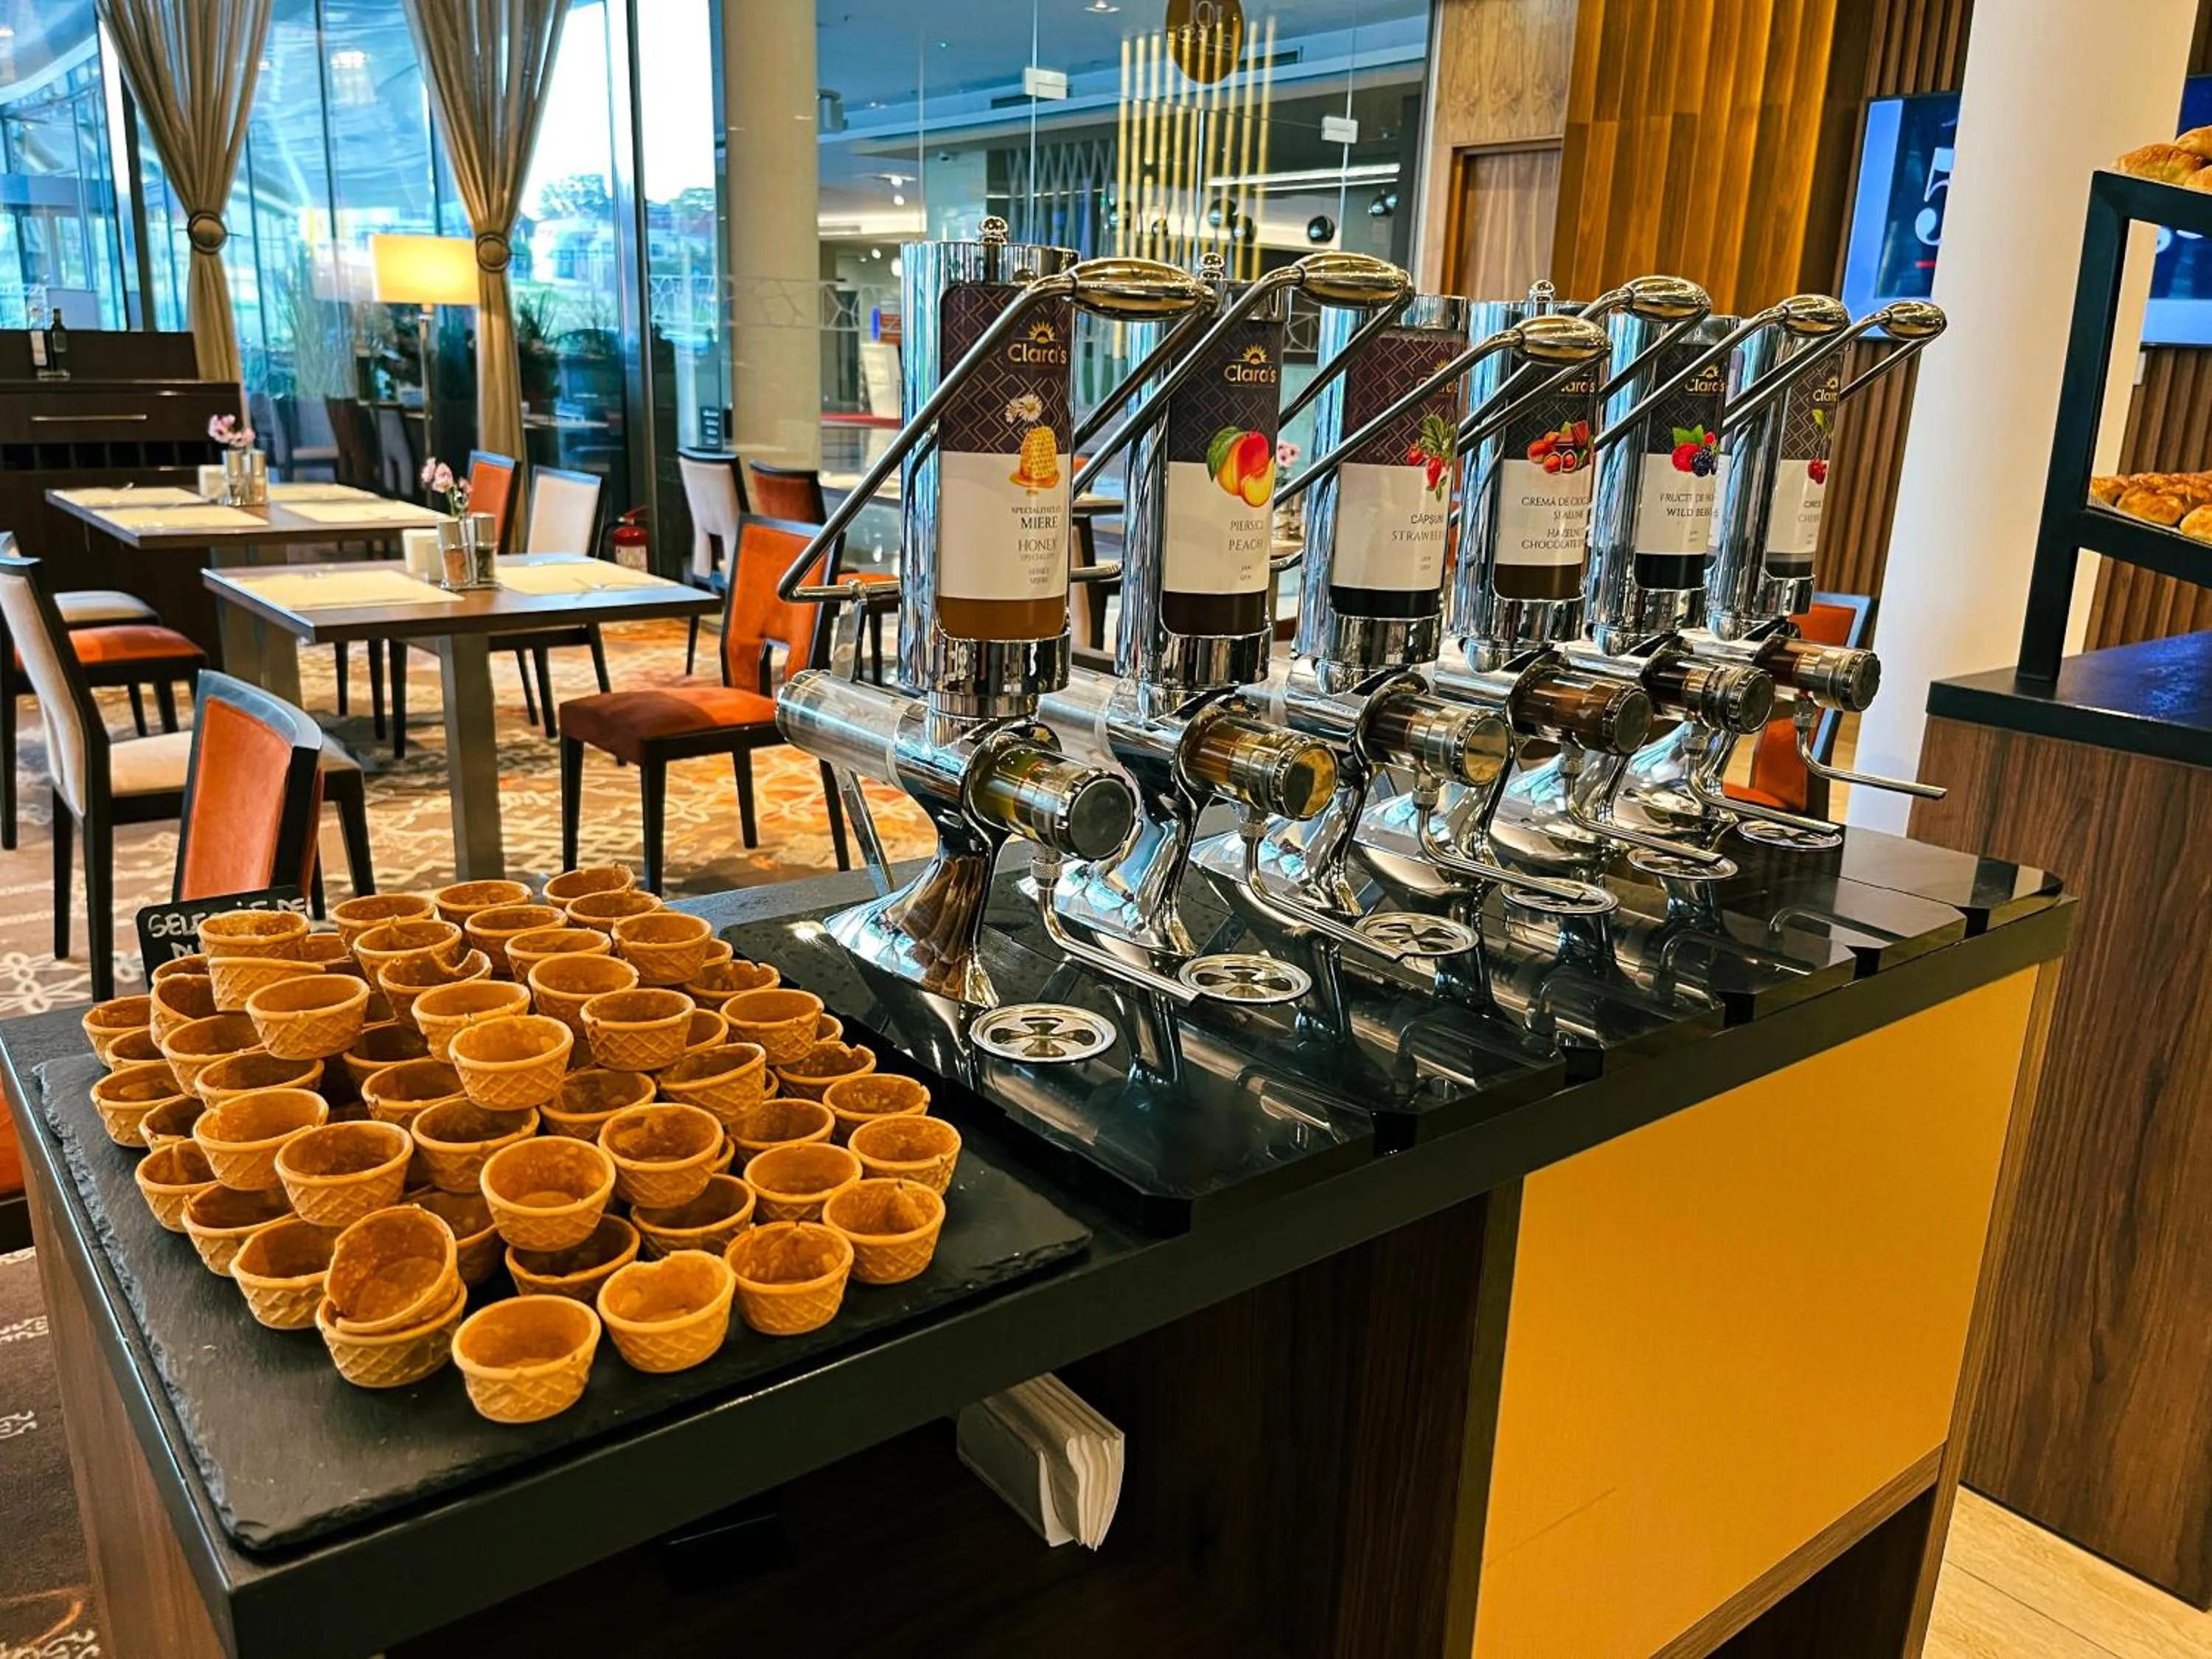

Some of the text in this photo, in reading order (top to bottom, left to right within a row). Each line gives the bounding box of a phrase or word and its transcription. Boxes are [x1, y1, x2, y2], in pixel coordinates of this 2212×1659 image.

[1007, 343, 1067, 365] Clara's
[1224, 364, 1276, 383] Clara's
[1666, 507, 1694, 517] WILD
[1021, 516, 1058, 529] MIERE
[1018, 538, 1057, 552] HONEY
[1228, 538, 1263, 551] PEACH
